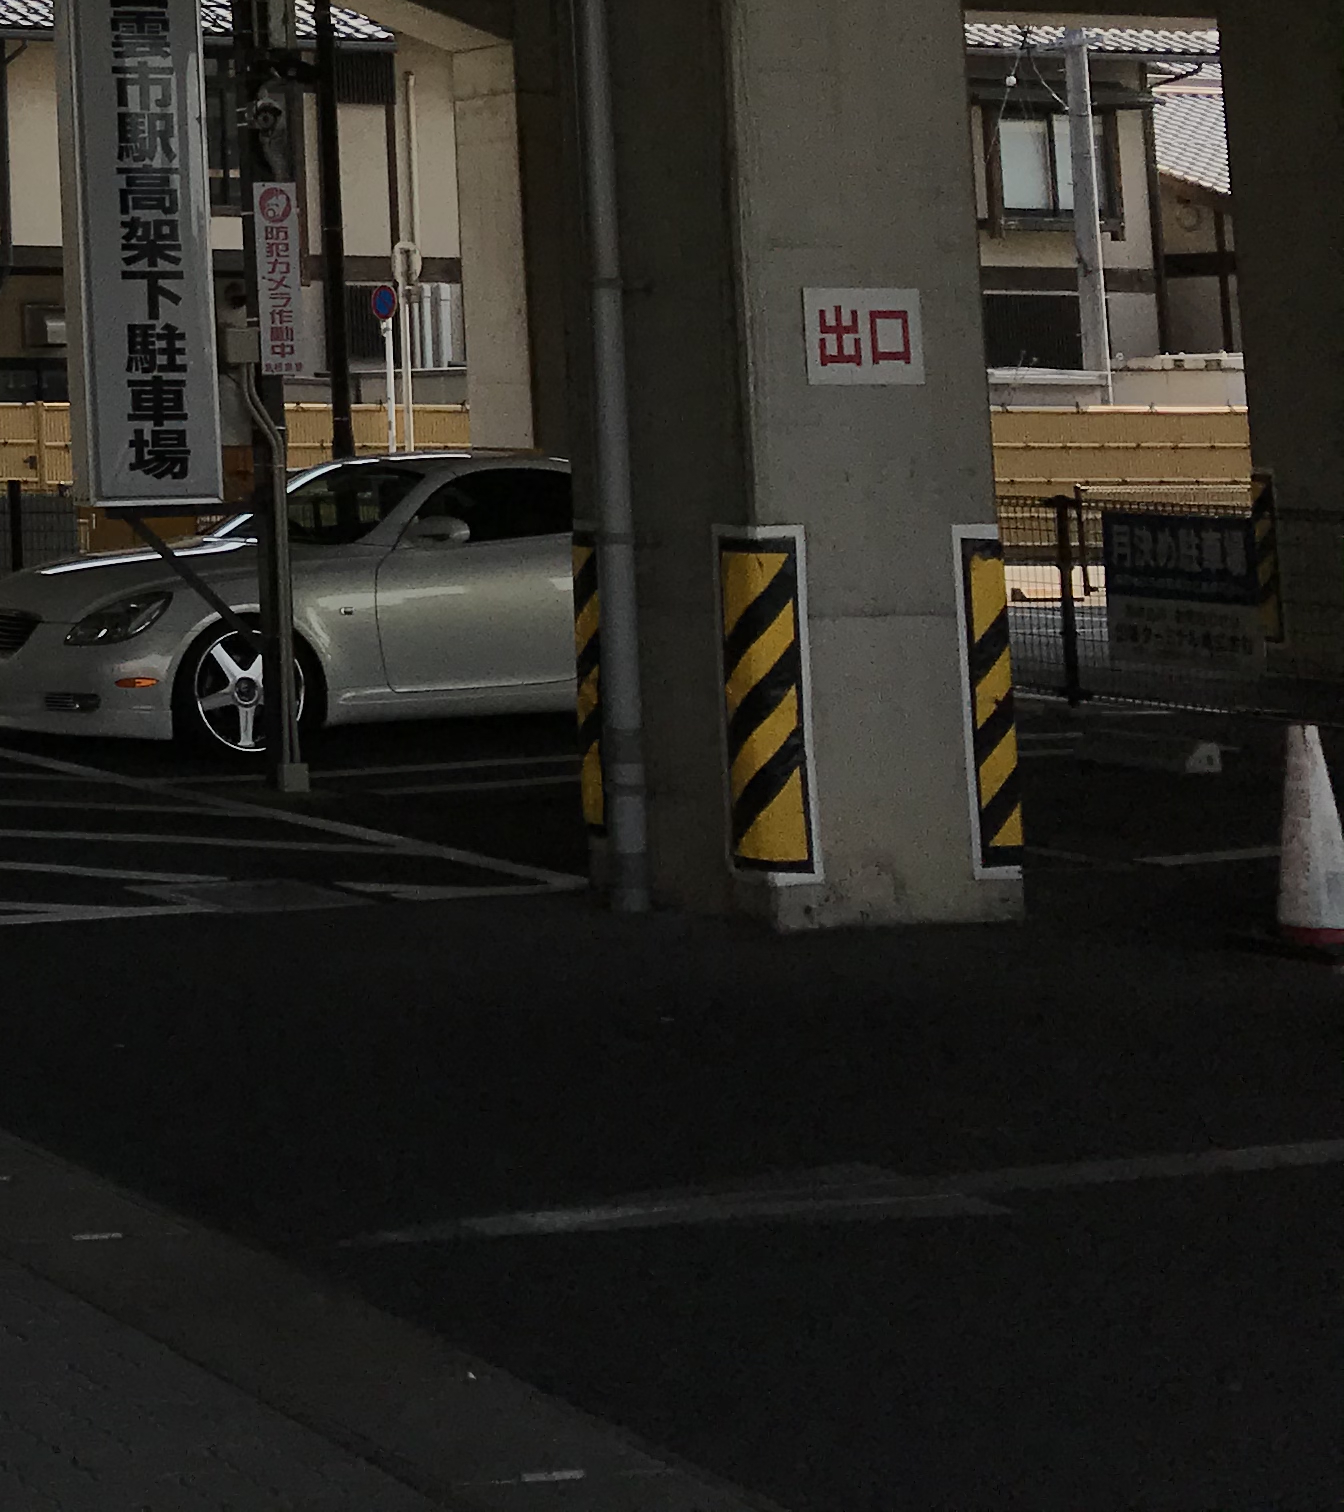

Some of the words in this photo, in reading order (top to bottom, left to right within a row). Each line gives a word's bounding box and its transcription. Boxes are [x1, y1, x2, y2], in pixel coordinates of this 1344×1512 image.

[265, 225, 295, 358] 防犯カメラ作動中
[818, 305, 911, 367] 出口
[1112, 524, 1248, 577] 月決め駐車場
